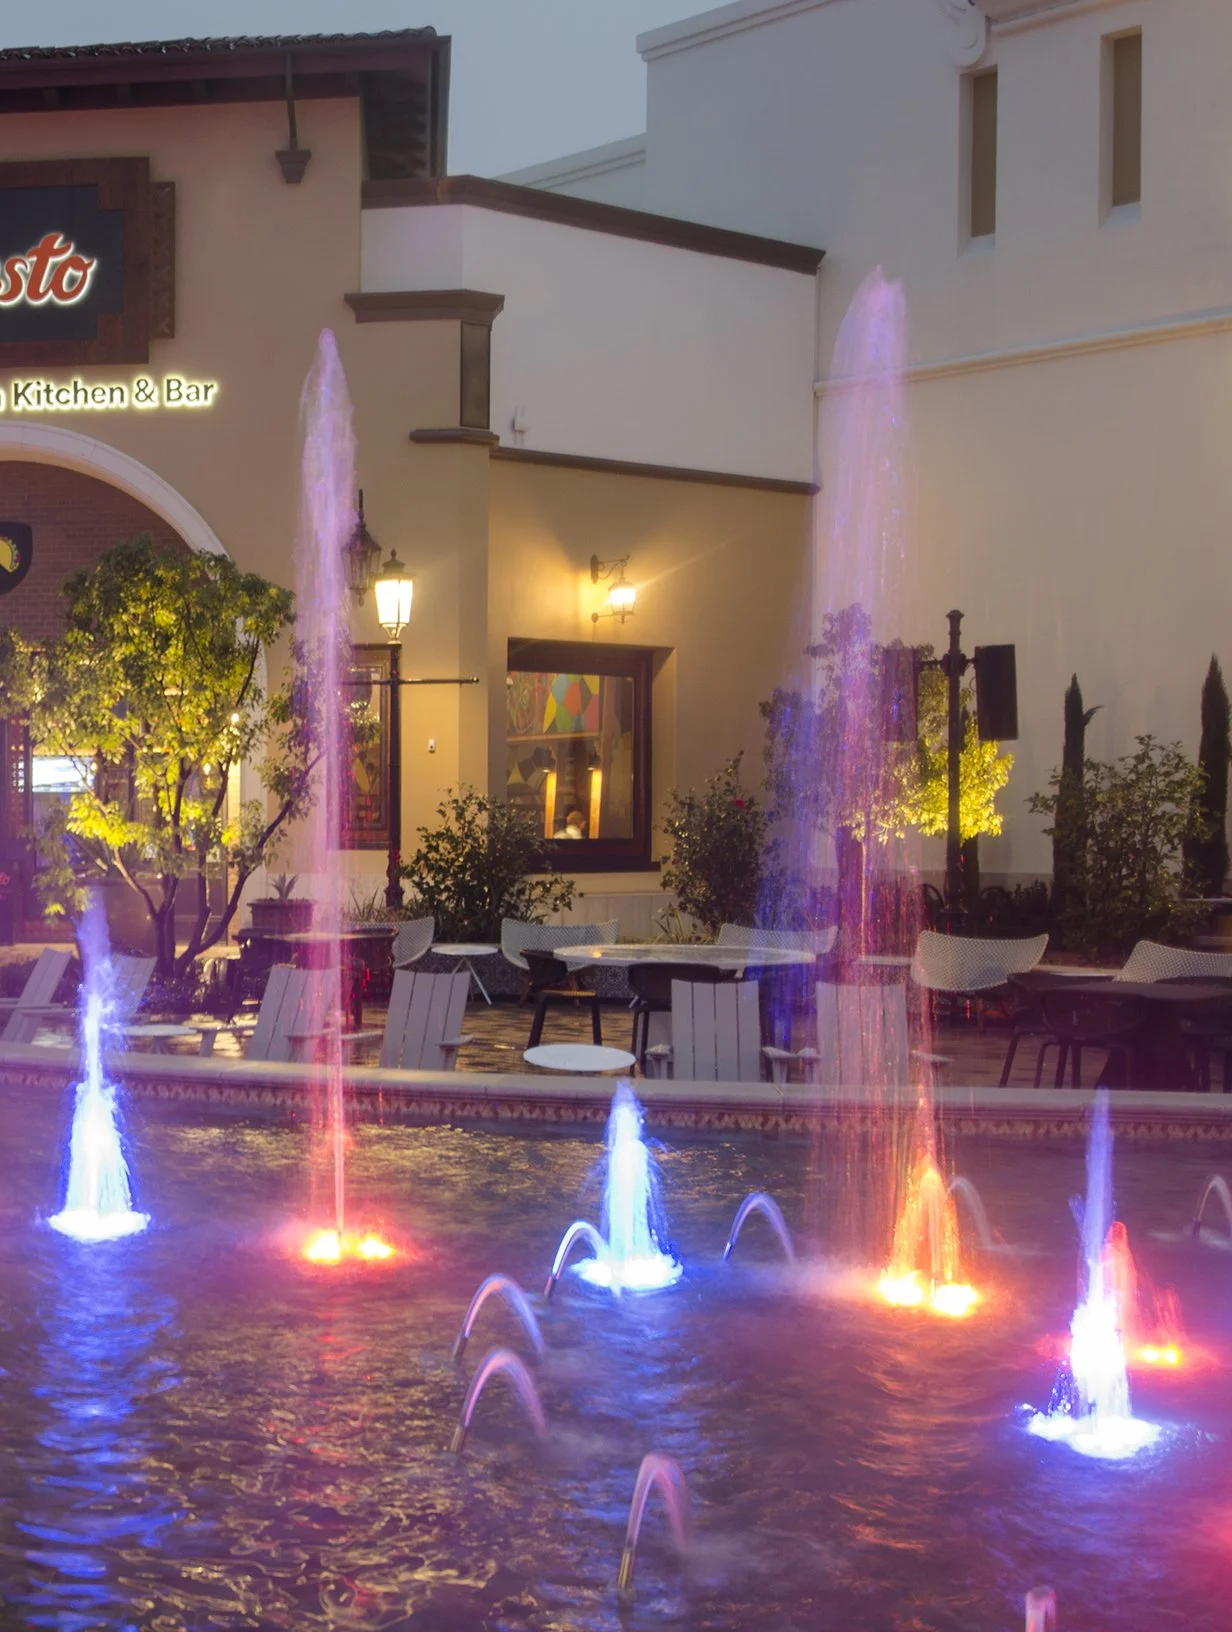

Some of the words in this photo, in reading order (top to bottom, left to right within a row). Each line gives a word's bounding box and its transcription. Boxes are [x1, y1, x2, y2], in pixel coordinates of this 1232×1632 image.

[13, 380, 125, 407] Kitchen
[134, 378, 155, 402] &
[166, 378, 215, 402] Bar
